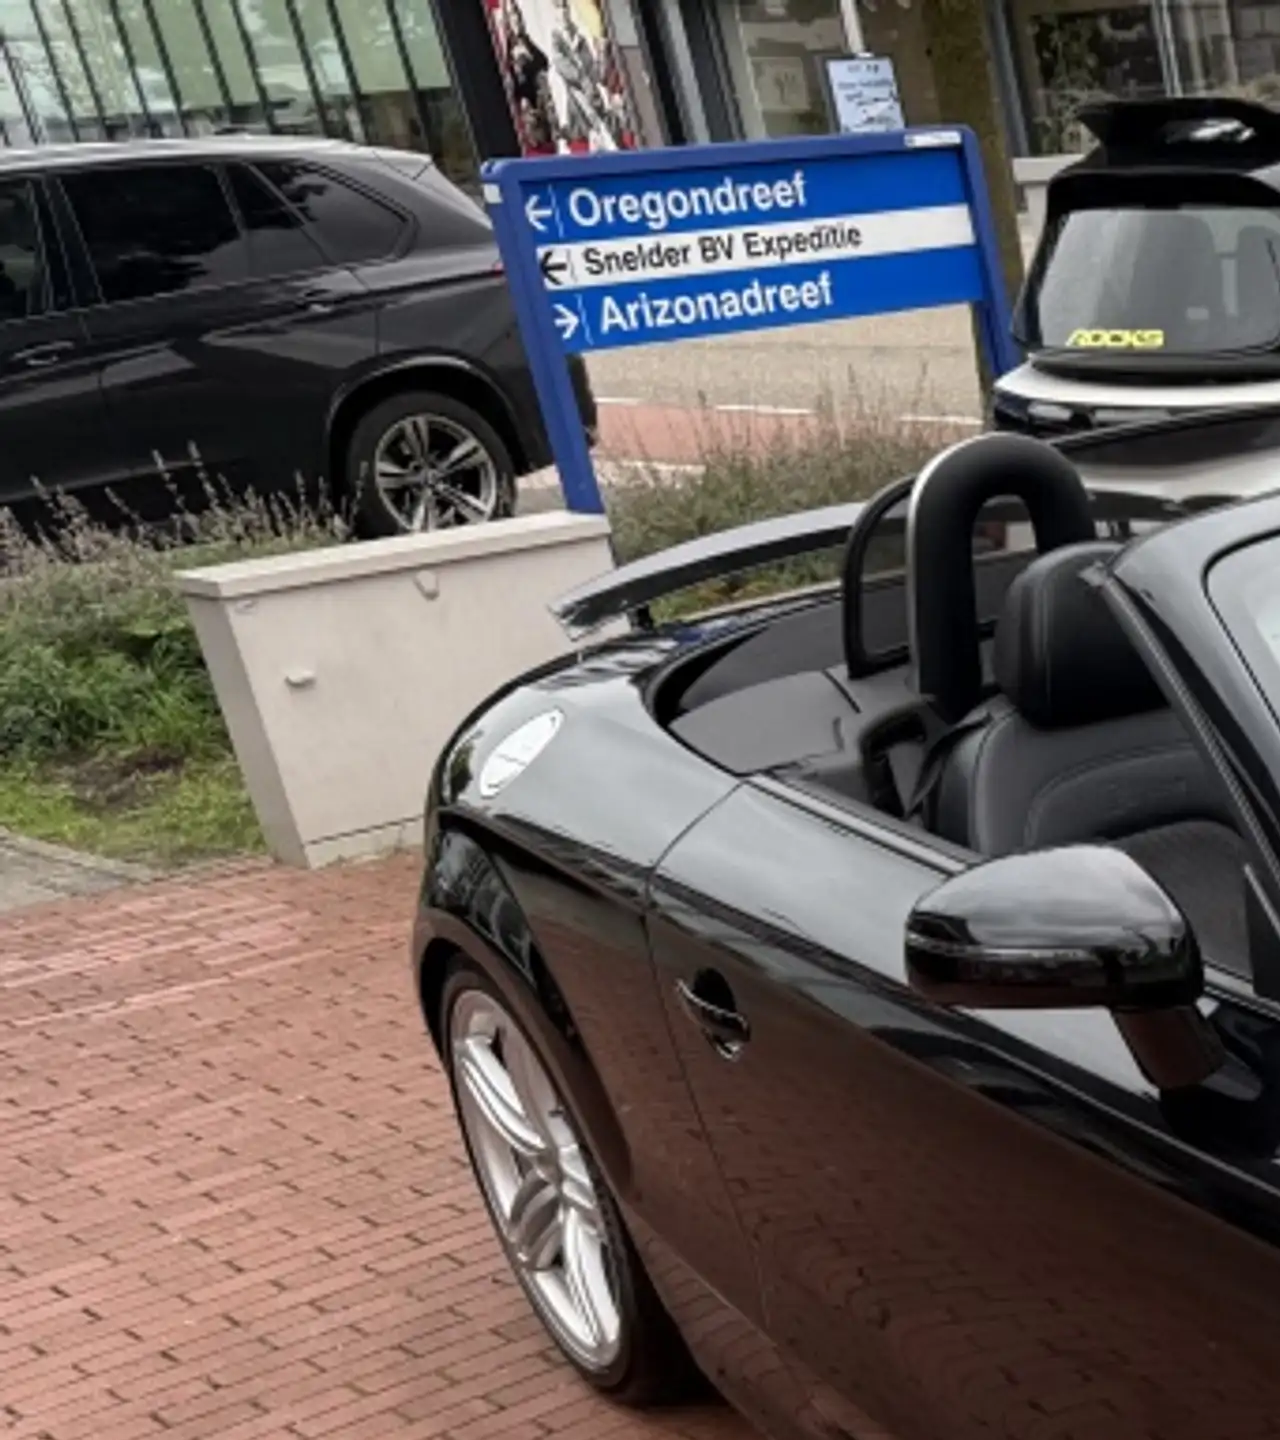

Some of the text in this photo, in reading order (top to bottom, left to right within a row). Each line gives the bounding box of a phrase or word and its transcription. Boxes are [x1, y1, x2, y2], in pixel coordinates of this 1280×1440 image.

[568, 169, 807, 231] Oregondreef
[584, 221, 863, 276] Snelder BV Expeditie
[600, 269, 834, 334] Arizonadreef
